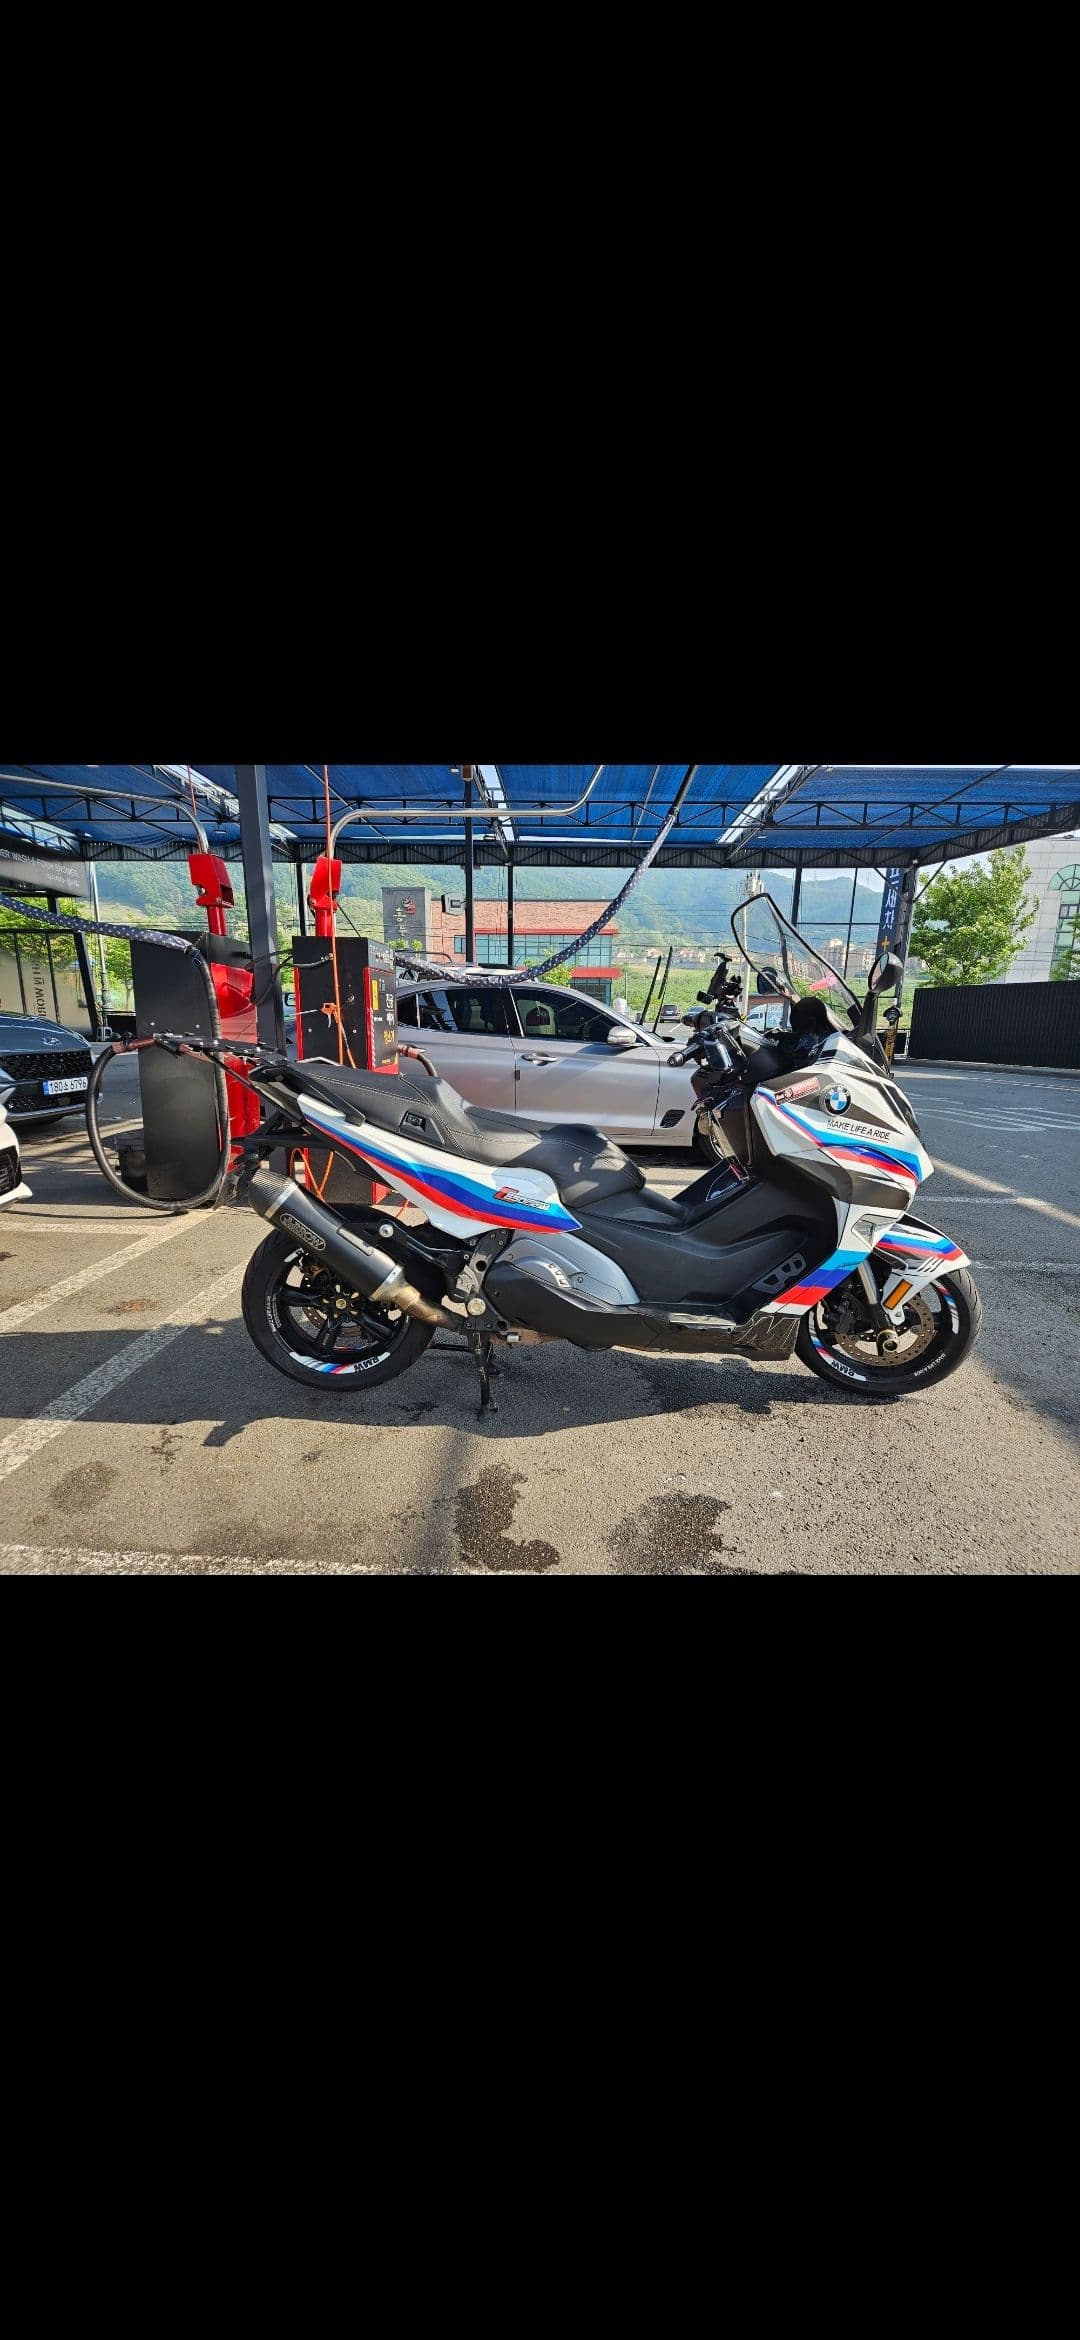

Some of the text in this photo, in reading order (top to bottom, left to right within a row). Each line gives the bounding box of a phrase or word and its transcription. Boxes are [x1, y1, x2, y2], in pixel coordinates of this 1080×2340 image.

[827, 1120, 850, 1131] MAKE
[850, 1124, 867, 1135] LIFE
[873, 1129, 891, 1140] RIDE
[354, 1356, 379, 1372] BMW
[831, 1359, 855, 1376] BMW
